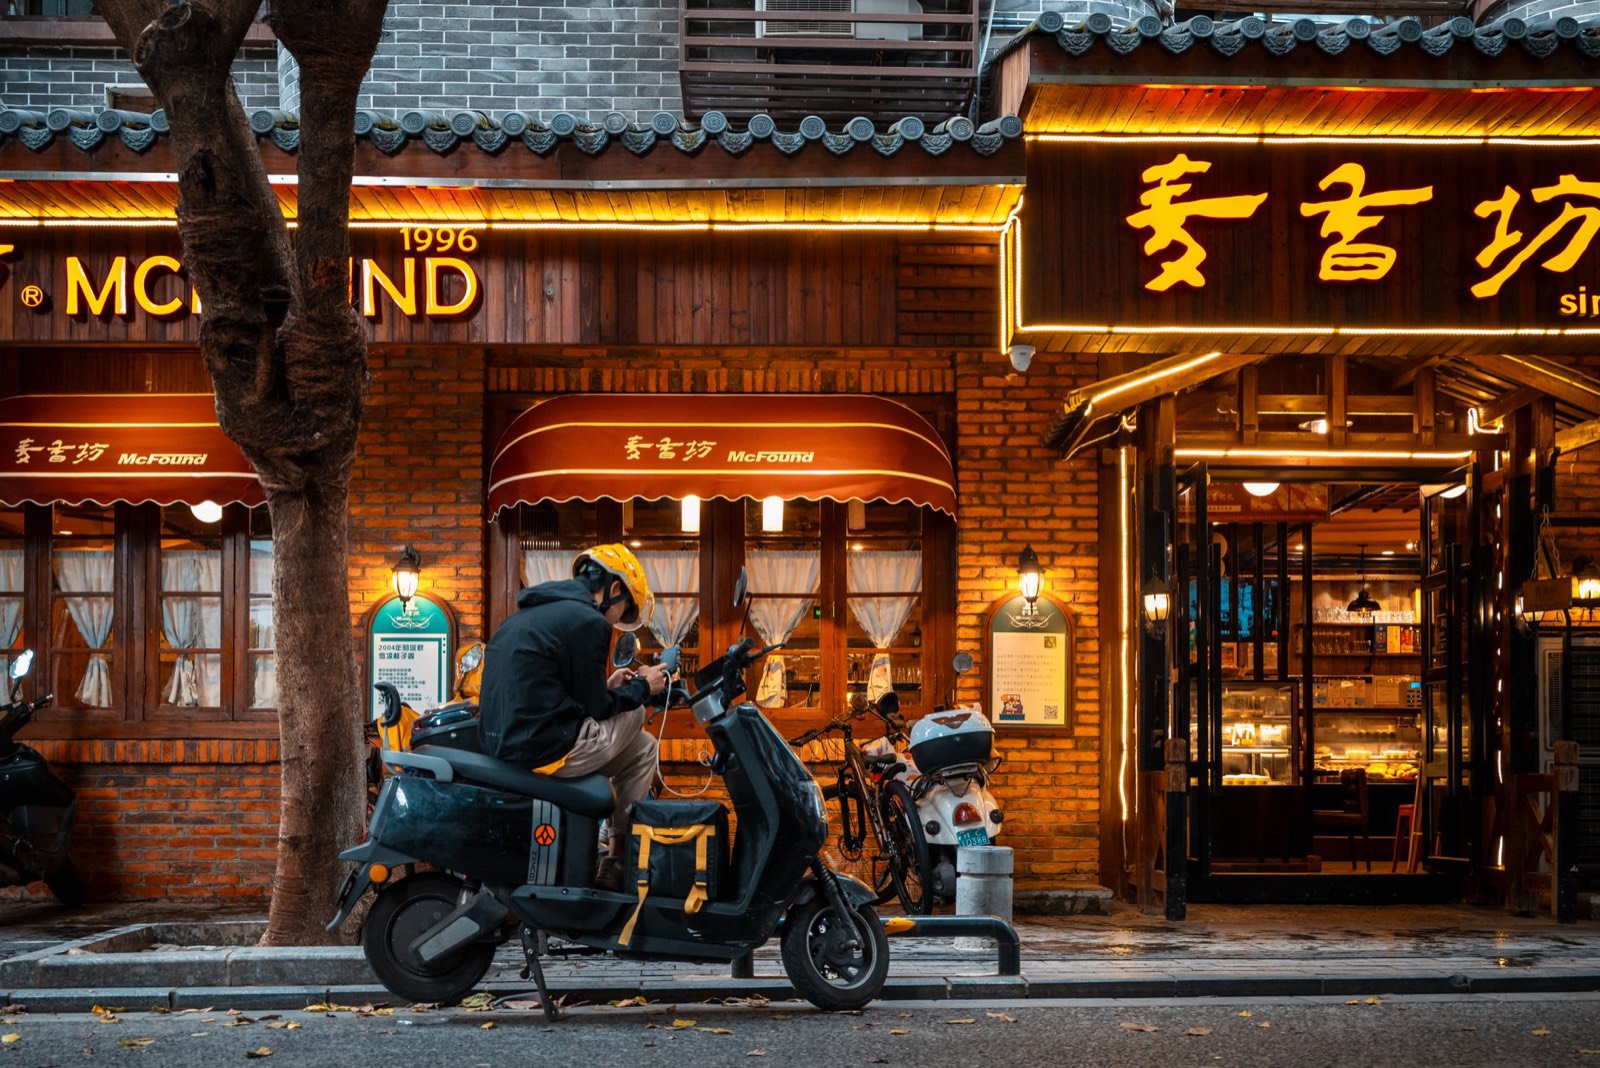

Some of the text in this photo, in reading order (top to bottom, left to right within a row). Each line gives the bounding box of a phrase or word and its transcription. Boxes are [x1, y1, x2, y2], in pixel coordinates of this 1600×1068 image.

[400, 226, 478, 252] 1996
[66, 256, 479, 316] MCND
[15, 438, 208, 465] 麦香坊 McFound
[624, 435, 815, 463] 麦香坊 McFound
